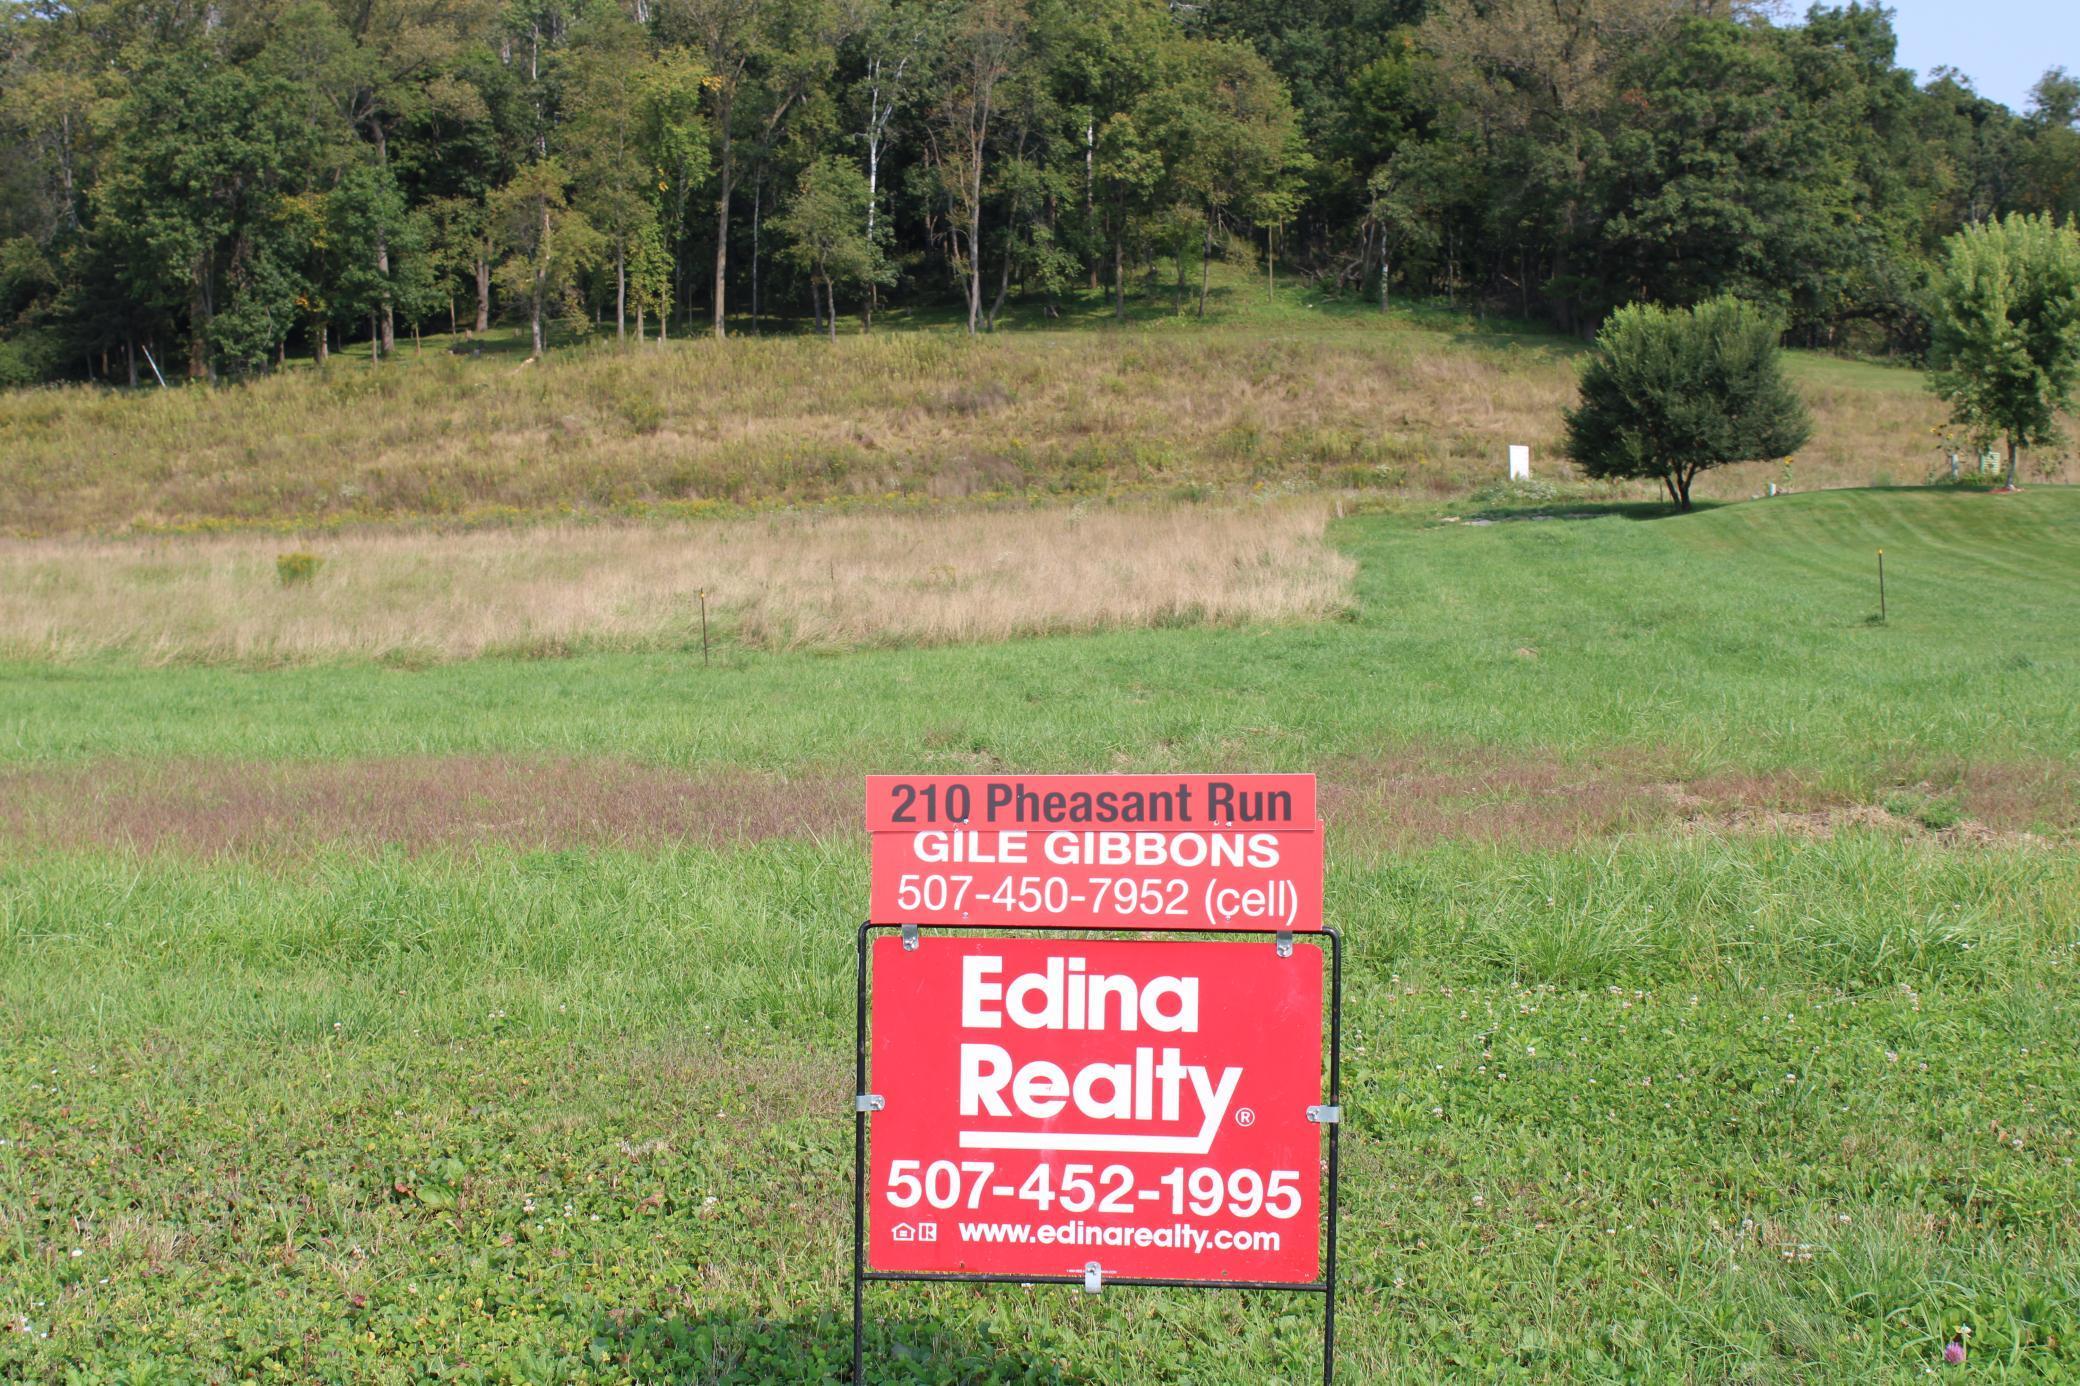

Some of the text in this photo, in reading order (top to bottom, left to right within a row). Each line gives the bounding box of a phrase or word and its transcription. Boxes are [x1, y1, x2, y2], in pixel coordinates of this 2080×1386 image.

[891, 782, 1292, 823] 210 Pheasant Run
[913, 831, 1280, 868] GILE GIBBONS
[897, 874, 1298, 926] 507-450-7952 (cell)
[962, 955, 1199, 1033] Edina
[959, 1043, 1243, 1154] Realty
[886, 1159, 1302, 1219] 507-452-1995
[958, 1220, 1280, 1254] www.edinarealty.com
